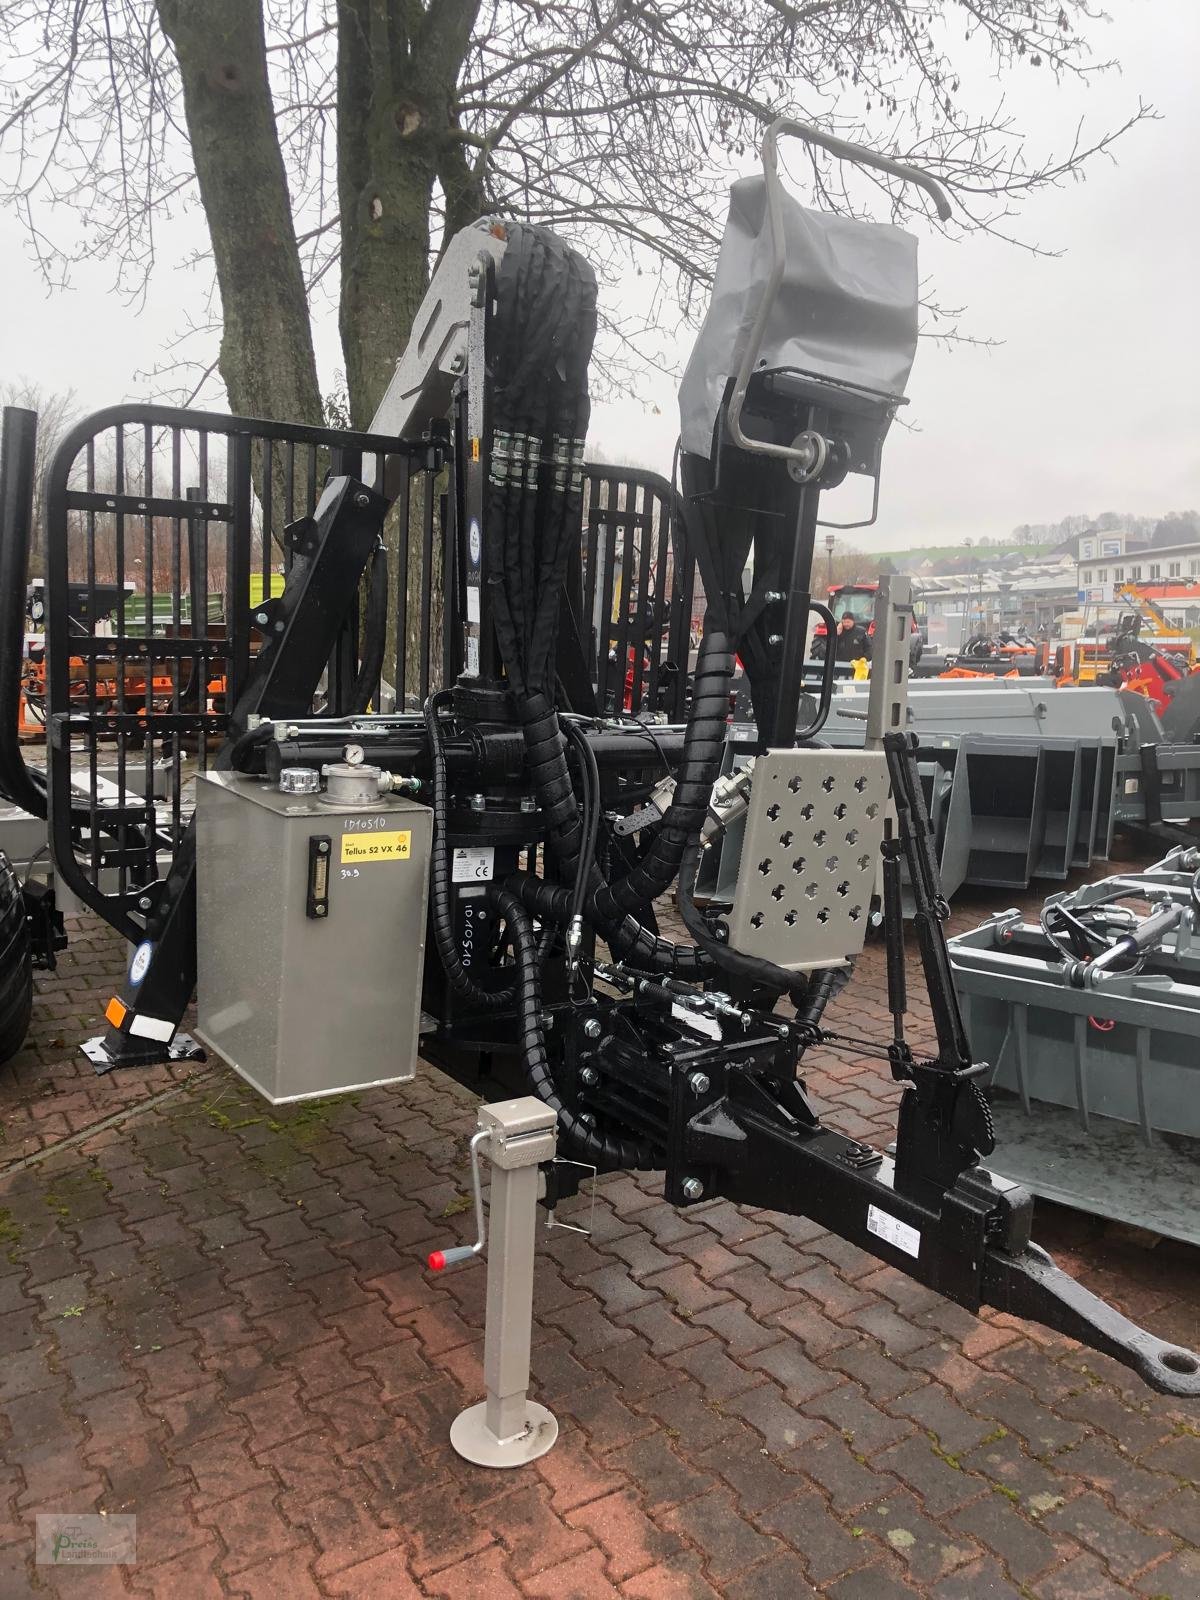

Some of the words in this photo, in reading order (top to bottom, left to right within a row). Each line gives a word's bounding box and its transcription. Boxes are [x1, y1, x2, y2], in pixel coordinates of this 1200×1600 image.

[345, 847, 367, 856] Tellus
[369, 846, 379, 854] S2
[381, 845, 392, 853] VX
[396, 844, 408, 853] 46
[462, 904, 473, 967] ID10510
